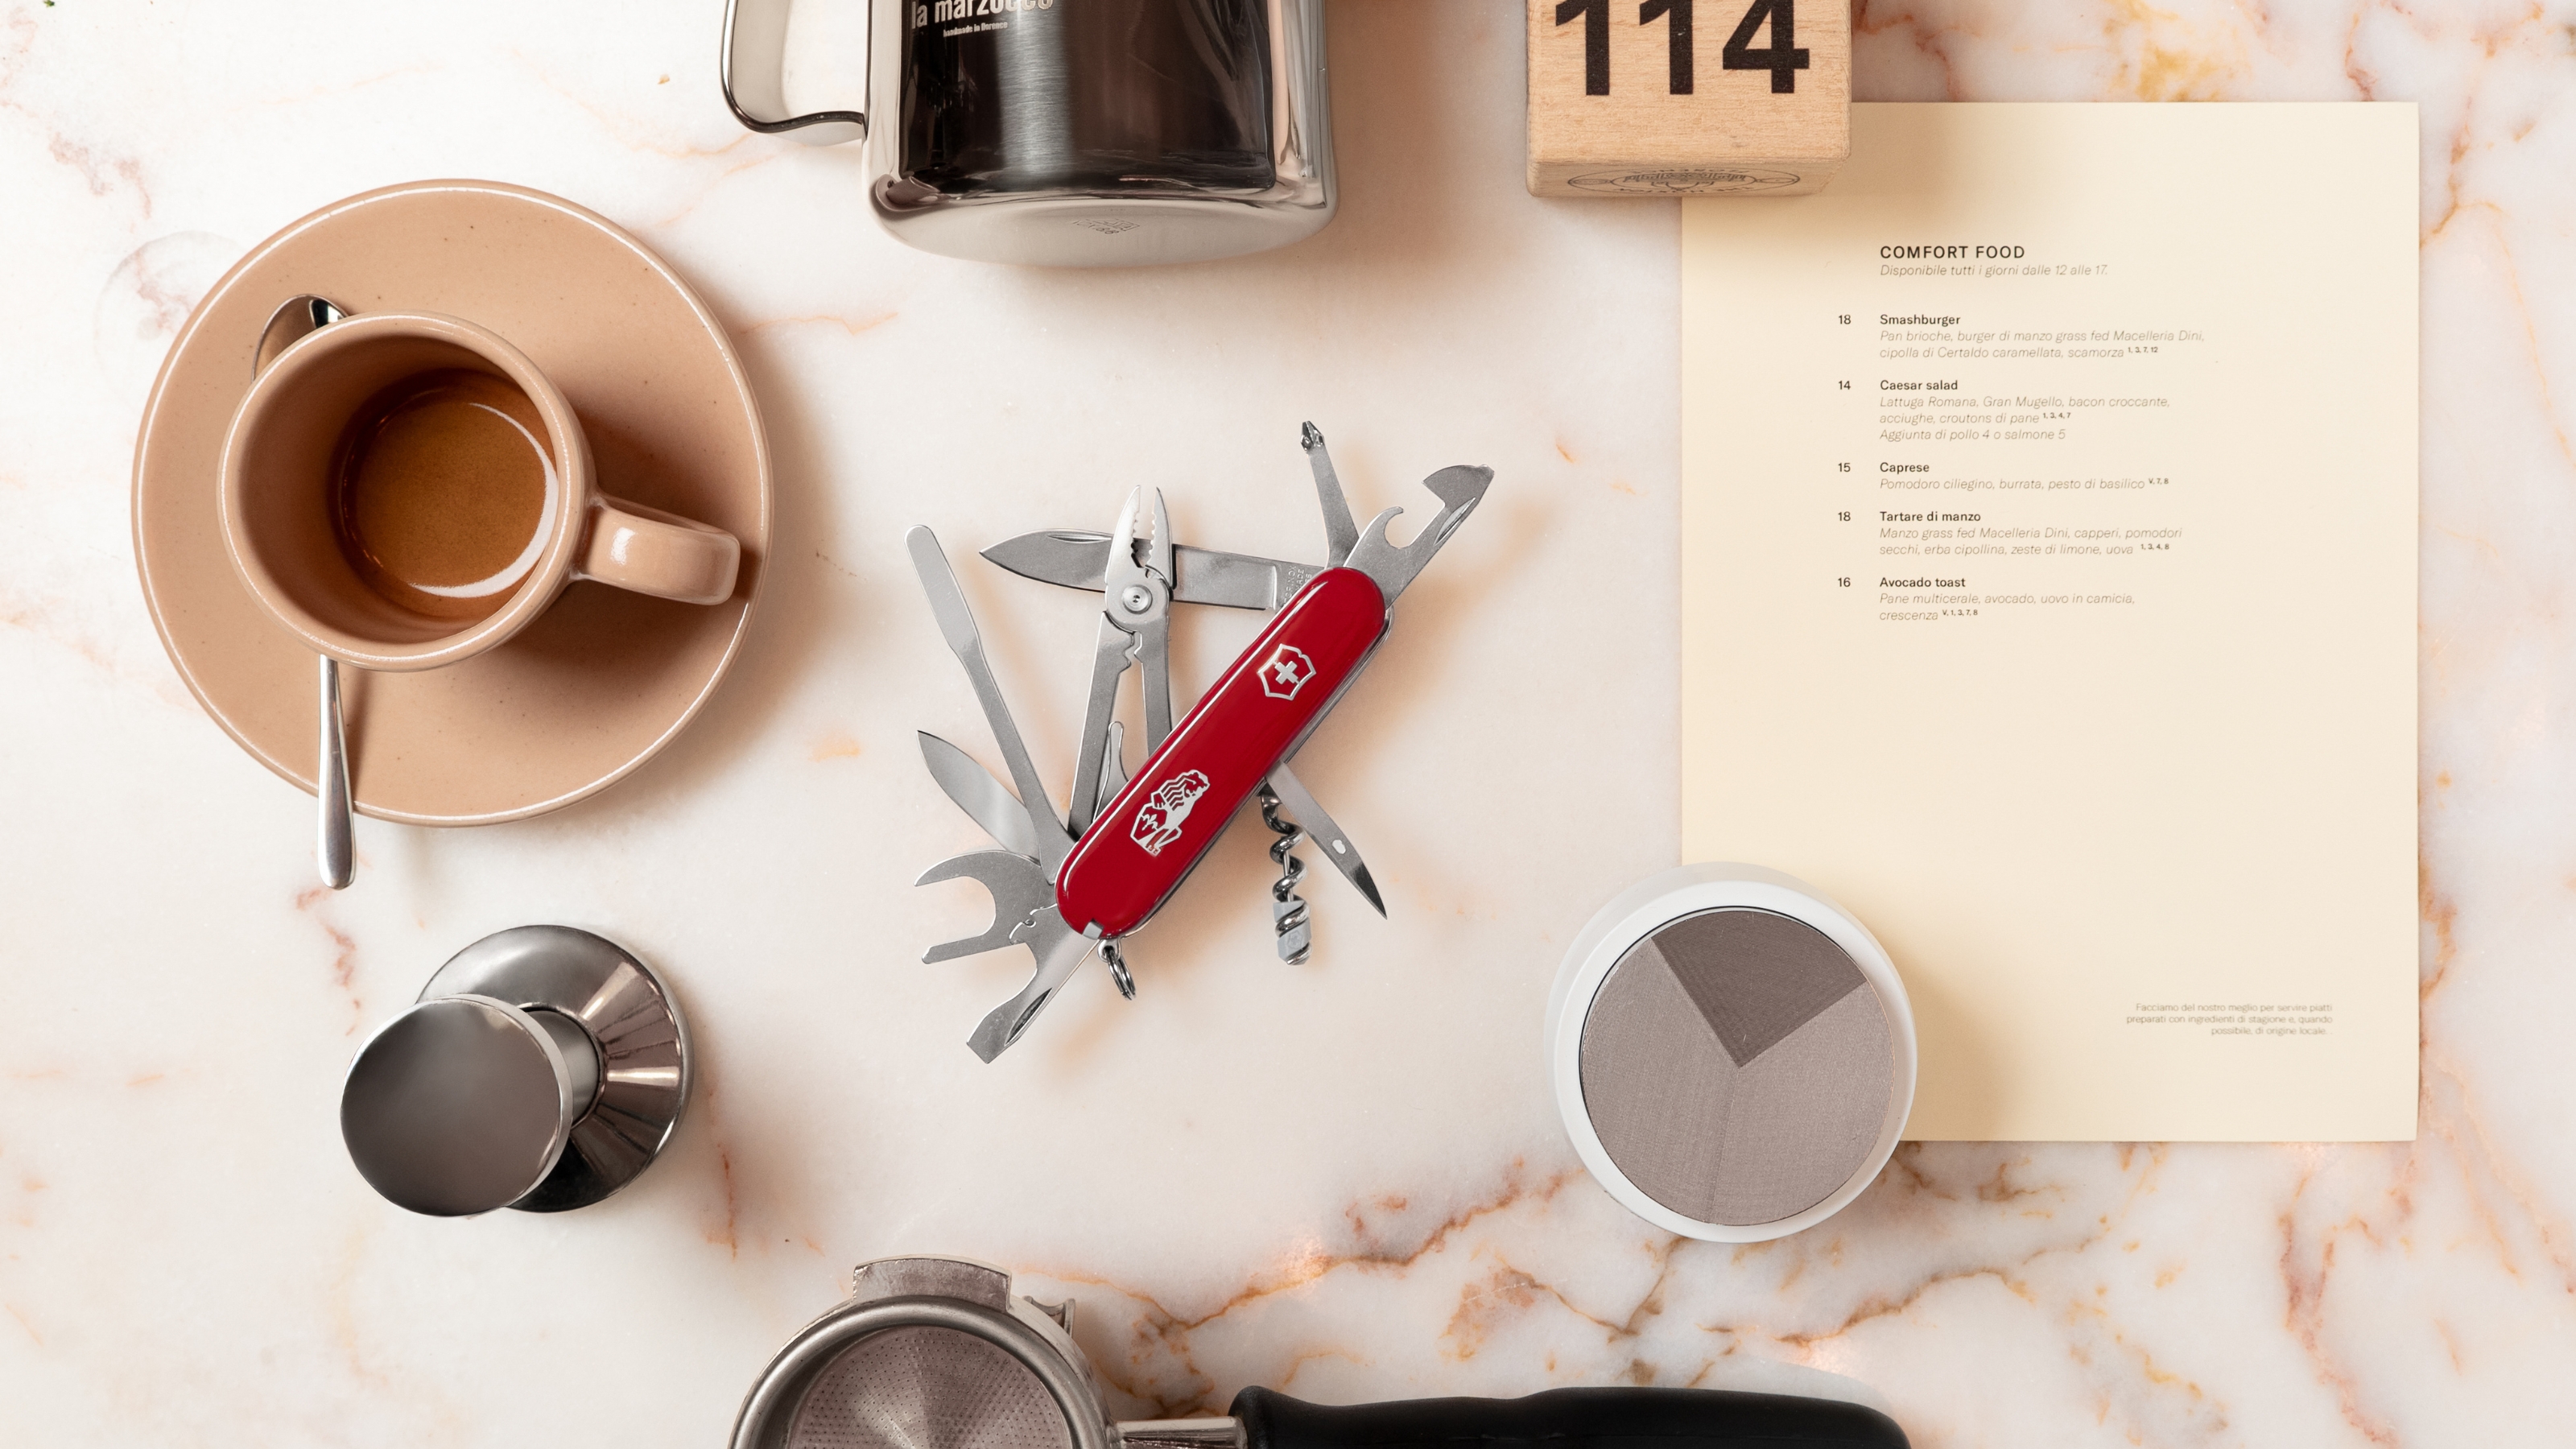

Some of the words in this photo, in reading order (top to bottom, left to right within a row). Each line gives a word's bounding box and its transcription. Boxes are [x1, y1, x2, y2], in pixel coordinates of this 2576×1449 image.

[911, 1, 927, 29] la
[943, 24, 972, 37] handmade
[974, 23, 980, 32] in
[981, 21, 1008, 31] florence
[1555, 0, 1810, 95] 114
[1880, 246, 1968, 259] COMFORT
[1975, 246, 2025, 258] FOOD
[1880, 263, 1948, 278] Disponibile
[1951, 264, 1975, 276] tutti
[1978, 264, 1983, 275] i
[1984, 264, 2019, 279] giorni
[2021, 264, 2052, 276] dalle
[2055, 263, 2068, 276] 12
[2069, 264, 2092, 276] alle
[2095, 263, 2108, 275] 17.
[1839, 314, 1852, 324] 18
[1879, 313, 1962, 328] Smashburger
[1880, 329, 1903, 342] Pan
[1905, 330, 1954, 343] brioche,
[1957, 330, 1996, 345] burger
[1998, 330, 2011, 342] di
[2013, 332, 2054, 342] manzo
[2054, 332, 2087, 345] grass
[2090, 329, 2111, 342] fed
[2112, 329, 2175, 342] Macelleria
[2178, 329, 2205, 342] Dini,
[1879, 346, 1920, 361] cipolla
[1922, 346, 1934, 359] di
[1937, 345, 1990, 359] Certaldo
[1992, 346, 2064, 359] caramellata,
[2067, 349, 2125, 359] scamorza
[1839, 380, 1851, 390] 14
[1879, 378, 1923, 391] Caesar
[1926, 378, 1959, 391] salad
[1879, 396, 1925, 411] Lattuga
[1927, 395, 1979, 408] Romana,
[1982, 395, 2013, 408] Gran
[2015, 395, 2065, 411] Mugello,
[2067, 395, 2106, 408] bacon
[2107, 397, 2170, 408] croccante,
[1879, 412, 1936, 427] acciughe,
[1938, 413, 1992, 424] croutons
[1995, 412, 2007, 424] di
[2009, 415, 2040, 426] pane
[1878, 428, 1932, 444] Aggiunta
[1934, 428, 1947, 440] di
[1949, 428, 1980, 443] pollo
[1981, 428, 1991, 440] 4
[1992, 431, 2002, 440] o
[2004, 428, 2055, 440] salmone
[2058, 427, 2066, 440] 5
[1838, 462, 1851, 473] 15
[1879, 460, 1930, 476] Caprese
[1879, 477, 1941, 490] Pomodoro
[1942, 477, 1996, 493] ciliegino,
[1998, 478, 2045, 490] burrata,
[2047, 479, 2082, 492] pesto
[2083, 477, 2096, 490] di
[2099, 477, 2146, 490] basilico
[1838, 511, 1851, 522] 18
[1879, 510, 1924, 522] Tartare
[1926, 510, 1938, 522] di
[1941, 513, 1982, 522] manzo
[1879, 526, 1919, 539] Manzo
[1921, 529, 1954, 542] grass
[1956, 526, 1976, 539] fed
[1979, 526, 2041, 539] Macelleria
[2044, 526, 2070, 539] Dini,
[2074, 527, 2122, 541] capperi,
[2124, 526, 2183, 540] pomodori
[1879, 543, 1921, 556] secchi,
[1923, 543, 1951, 555] erba
[1954, 543, 2008, 557] cipollina,
[2010, 544, 2042, 555] zeste
[2044, 543, 2057, 555] di
[2059, 543, 2103, 556] limone,
[2105, 545, 2134, 555] uova
[1838, 577, 1851, 588] 16
[1879, 576, 1933, 588] Avocado
[1934, 577, 1967, 588] toast
[1879, 592, 1910, 605] Pane
[1912, 592, 1981, 605] multicerale,
[1984, 592, 2037, 605] avocado,
[2040, 595, 2070, 605] uovo
[2071, 592, 2084, 604] in
[2086, 592, 2136, 605] camicia,
[1878, 611, 1939, 621] crescenza
[2135, 1002, 2180, 1012] Facciamo
[2180, 1003, 2196, 1012] del
[2197, 1004, 2227, 1012] nostro
[2227, 1003, 2259, 1014] meglio
[2259, 1005, 2275, 1013] per
[2277, 1005, 2308, 1013] servire
[2309, 1004, 2333, 1013] piatti
[2125, 1015, 2167, 1025] preparati
[2168, 1016, 2186, 1024] con
[2187, 1014, 2235, 1026] ingredienti
[2236, 1014, 2246, 1024] di
[2248, 1015, 2287, 1026] stagione
[2297, 1015, 2334, 1025] quando
[2211, 1026, 2253, 1037] possibile,
[2254, 1026, 2264, 1035] di
[2265, 1027, 2297, 1038] origine
